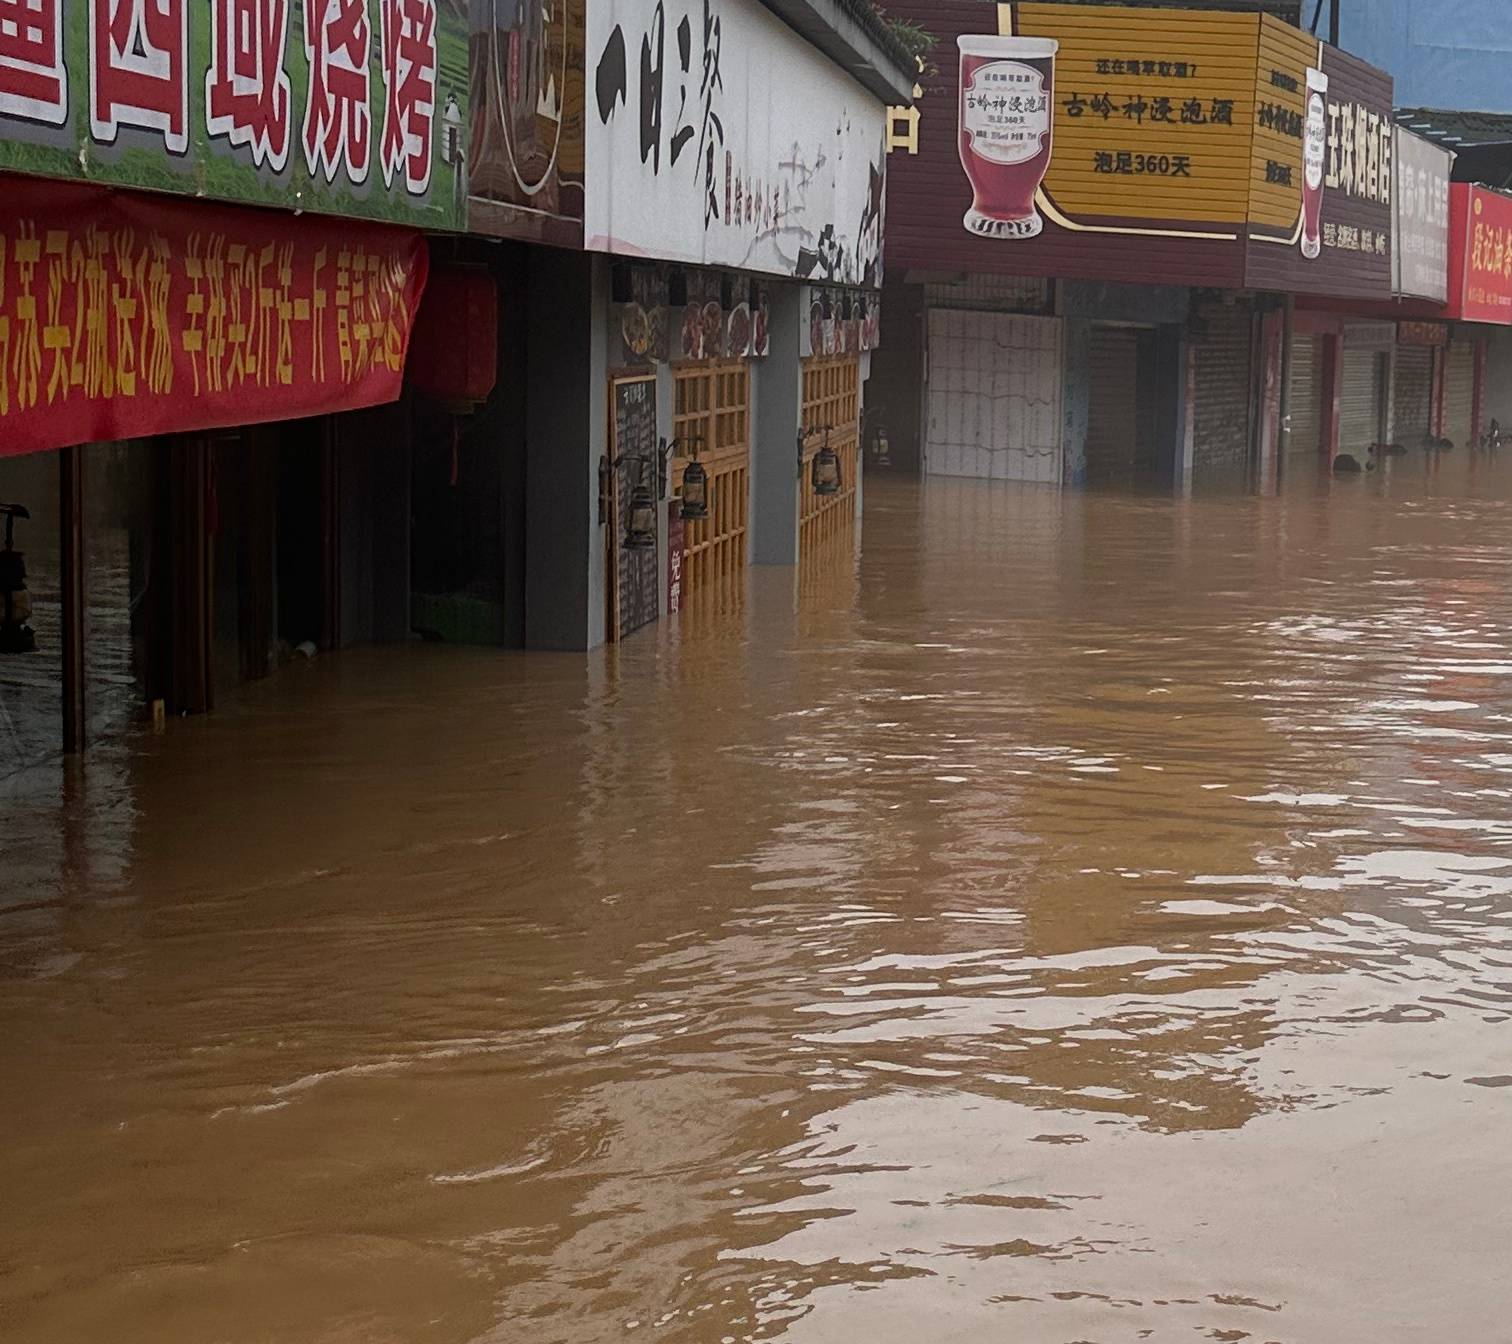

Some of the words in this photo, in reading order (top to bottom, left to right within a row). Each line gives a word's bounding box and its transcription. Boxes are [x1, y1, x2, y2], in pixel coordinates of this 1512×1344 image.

[1094, 151, 1191, 178] 泡足360天
[0, 218, 174, 417] 苏买2瓶送1瓶
[182, 231, 327, 397] 羊排买2斤送一斤
